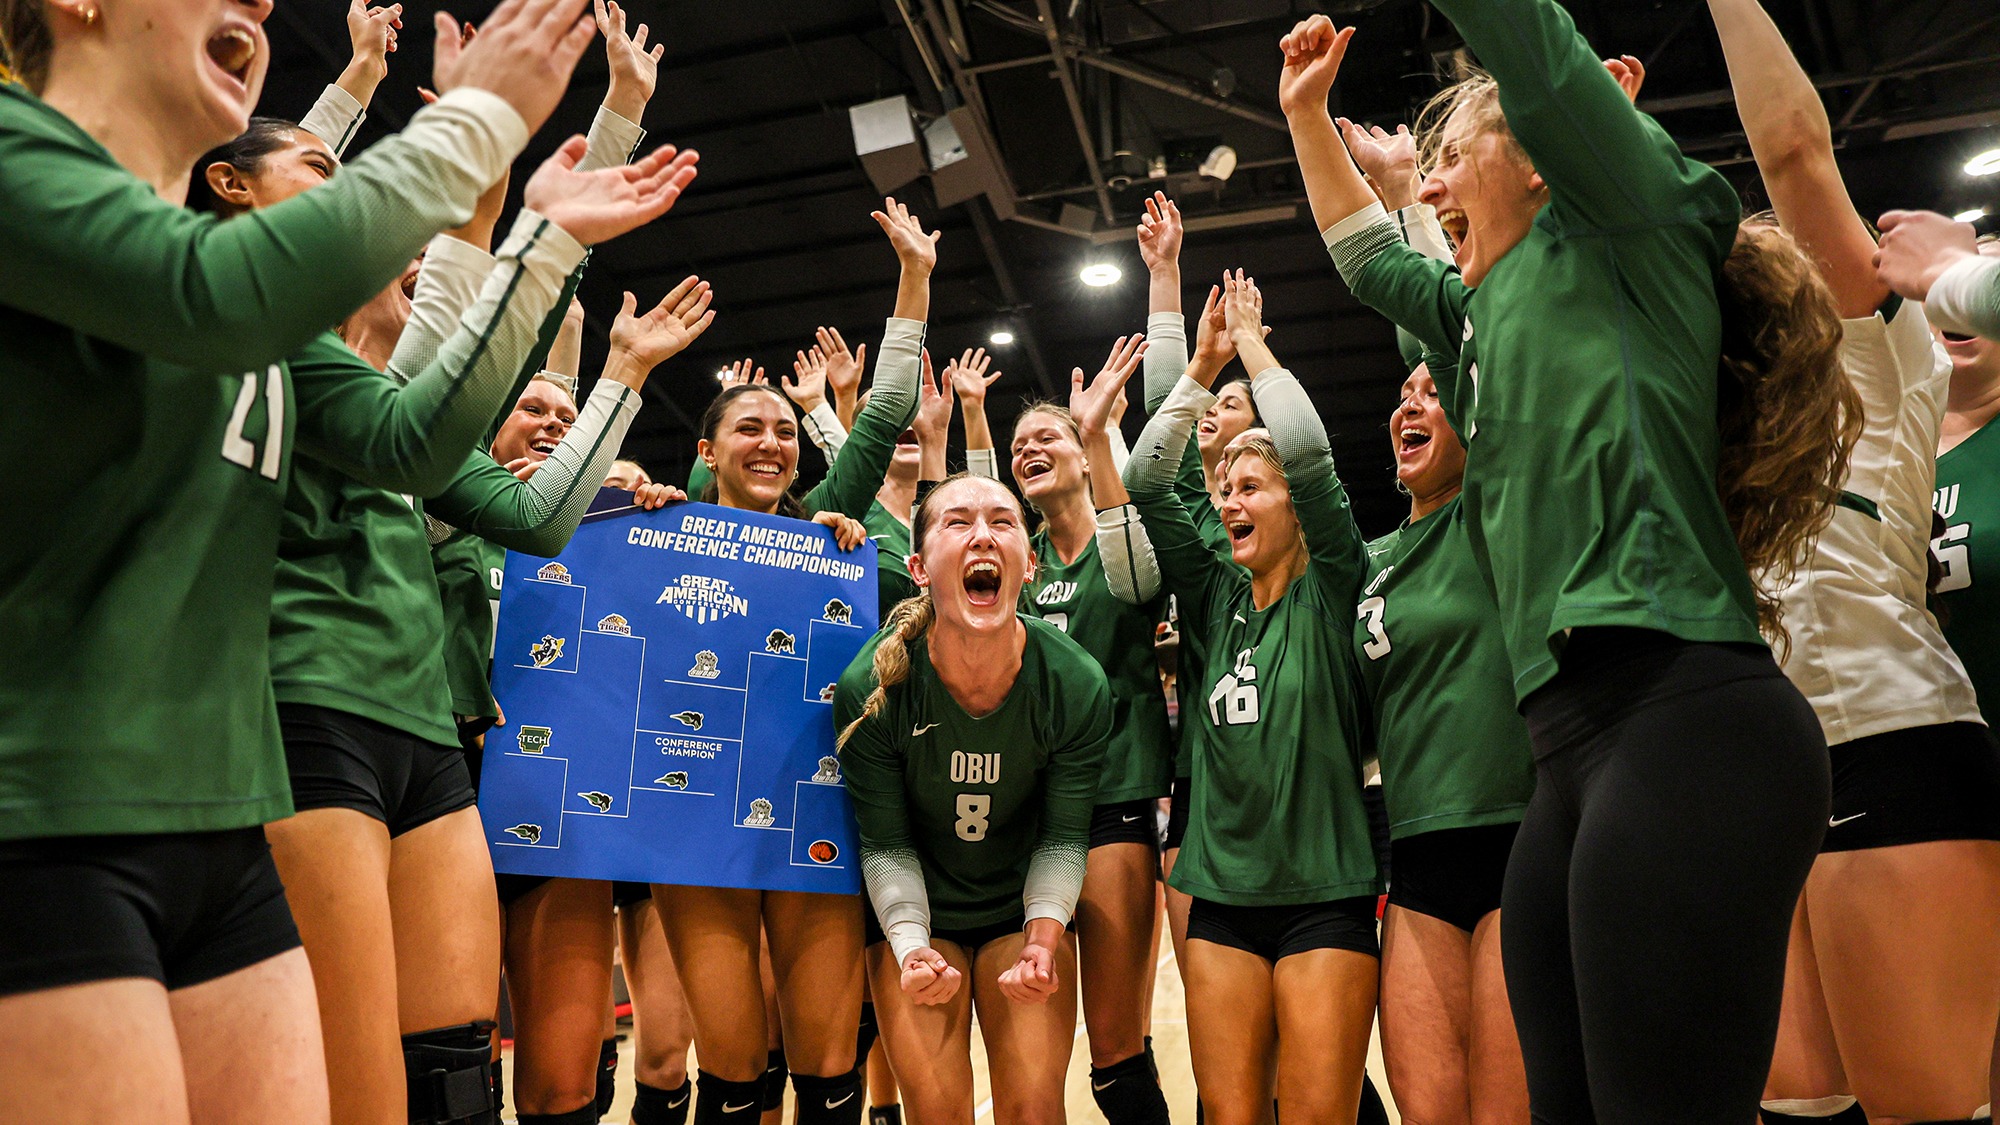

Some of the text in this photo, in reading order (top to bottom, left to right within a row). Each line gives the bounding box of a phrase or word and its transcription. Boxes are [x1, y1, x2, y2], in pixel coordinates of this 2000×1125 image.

[681, 515, 825, 555] GREAT AMERICAN
[627, 527, 864, 582] CONFERENCE CHAMPIONSHIP
[538, 571, 571, 583] TIGERS
[679, 575, 730, 593] GREAT
[656, 586, 748, 617] AMERICAN
[1035, 580, 1078, 606] OBU
[673, 599, 733, 613] CONFERENCE
[599, 623, 631, 635] TIGERS
[1357, 596, 1391, 661] 3
[521, 734, 547, 745] TECH
[654, 737, 722, 752] CONFERENCE
[661, 747, 715, 760] CHAMPION
[949, 749, 1001, 784] OBU
[954, 793, 991, 842] 8
